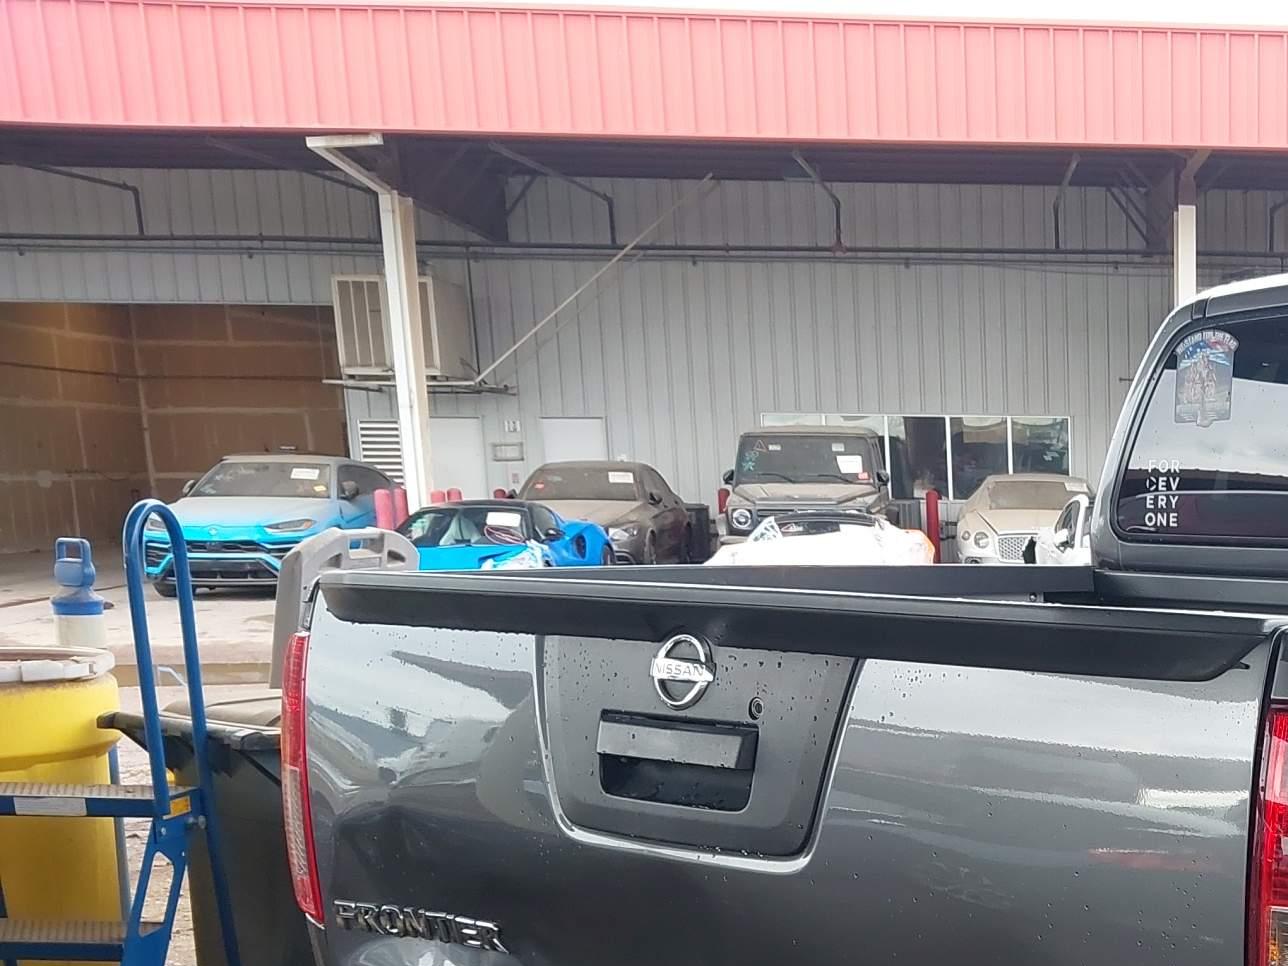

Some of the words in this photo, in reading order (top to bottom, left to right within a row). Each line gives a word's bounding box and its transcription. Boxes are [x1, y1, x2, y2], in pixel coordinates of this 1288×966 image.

[1148, 460, 1180, 473] FOR
[1146, 495, 1179, 509] ERY
[1144, 512, 1178, 527] ONE
[655, 662, 705, 677] NISSAN
[334, 900, 509, 954] FRONTIER
